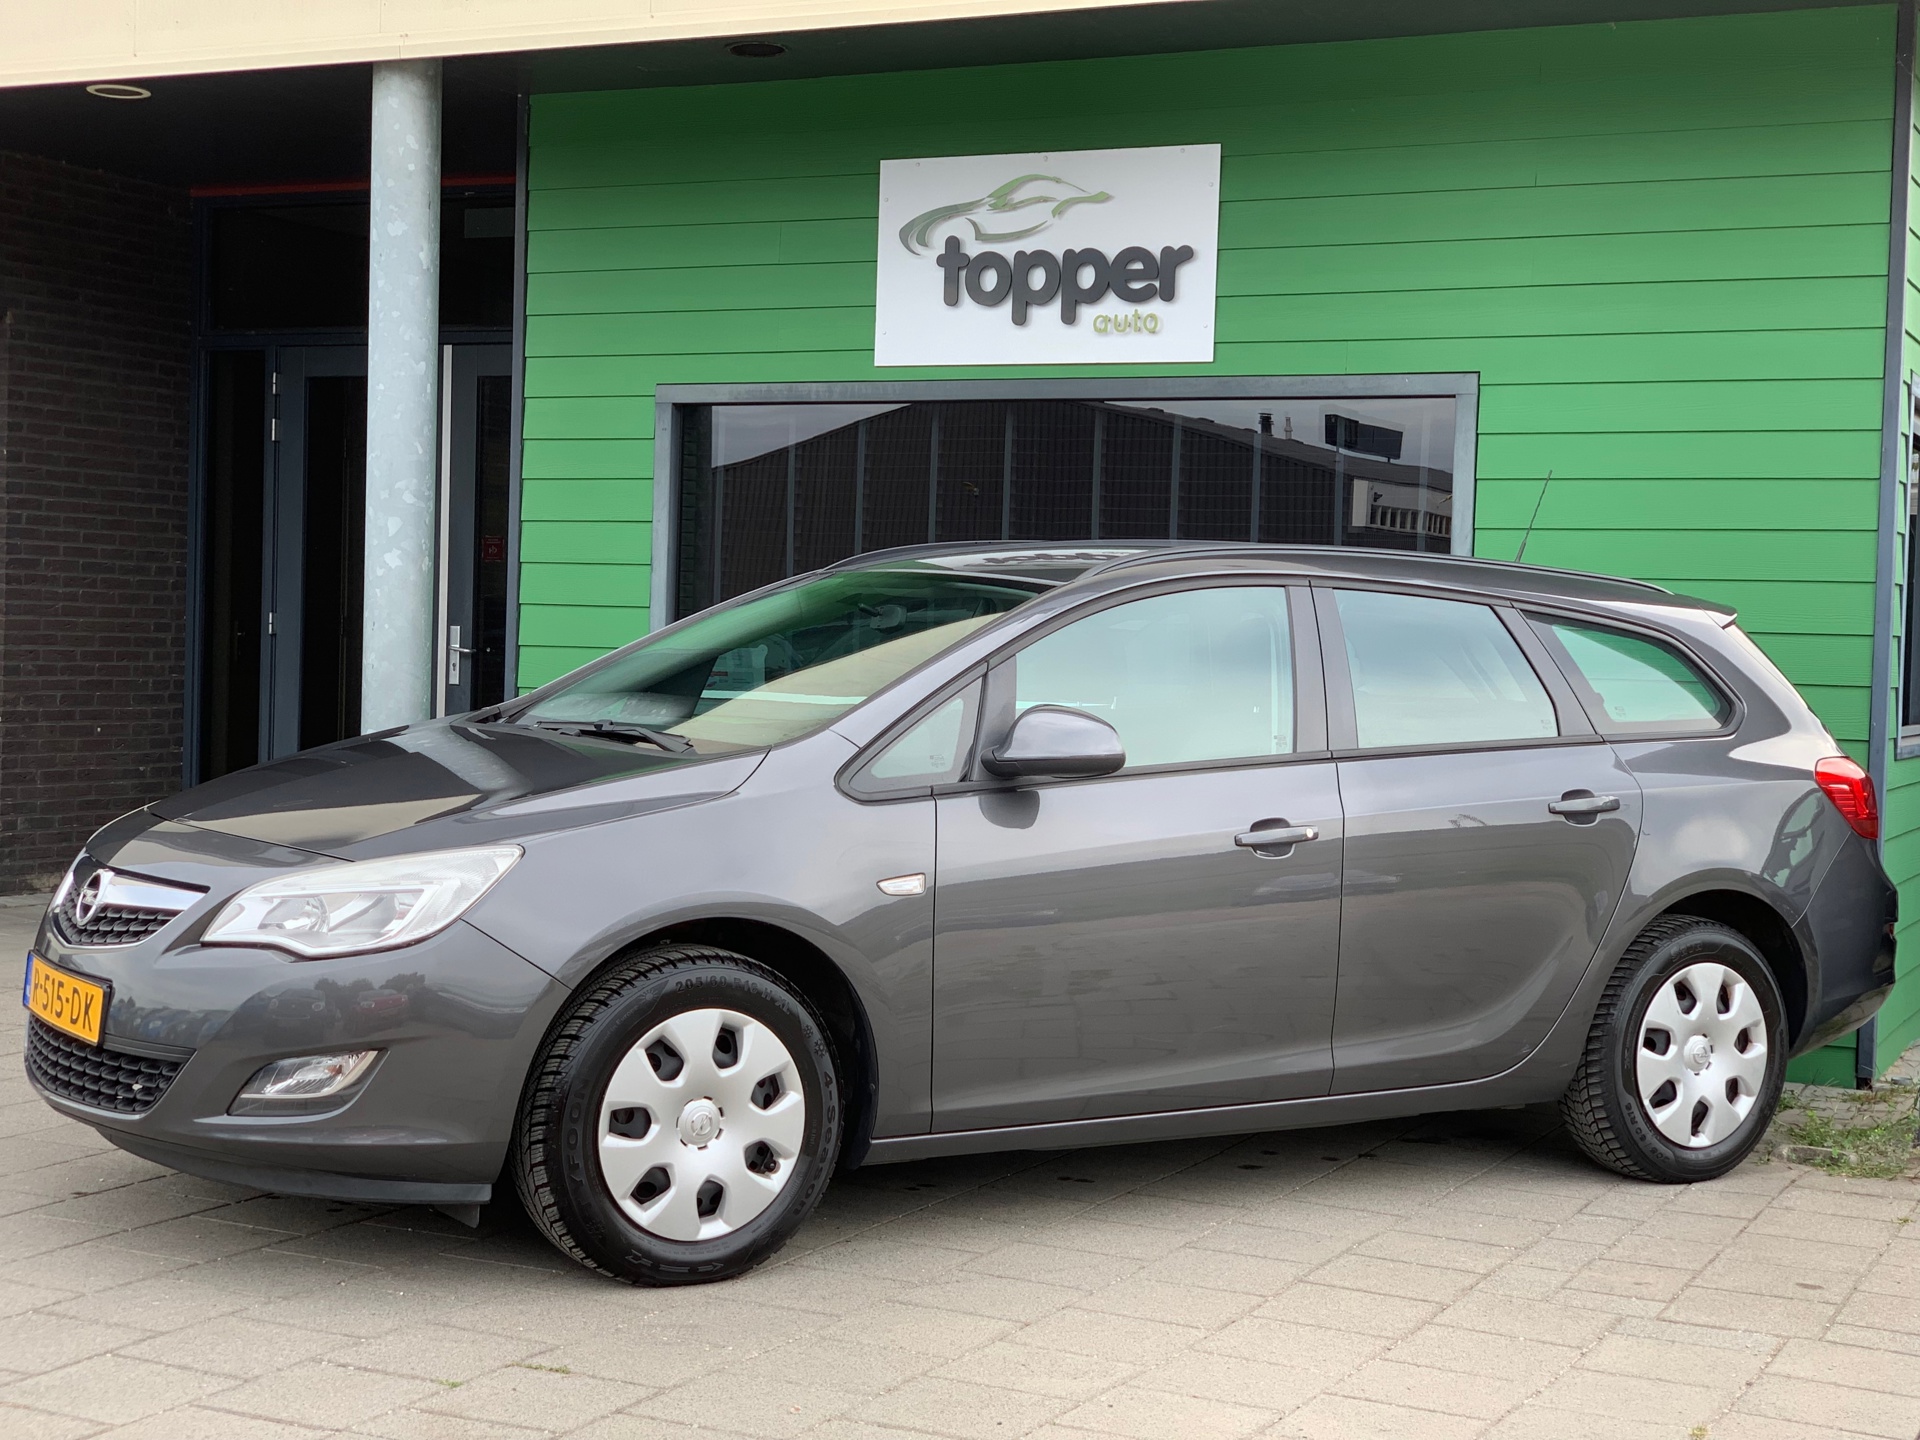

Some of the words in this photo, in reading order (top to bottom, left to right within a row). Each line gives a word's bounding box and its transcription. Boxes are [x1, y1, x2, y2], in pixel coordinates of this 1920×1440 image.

[936, 235, 1194, 325] topper
[1093, 309, 1158, 334] auto
[33, 967, 94, 1031] R-515-DK
